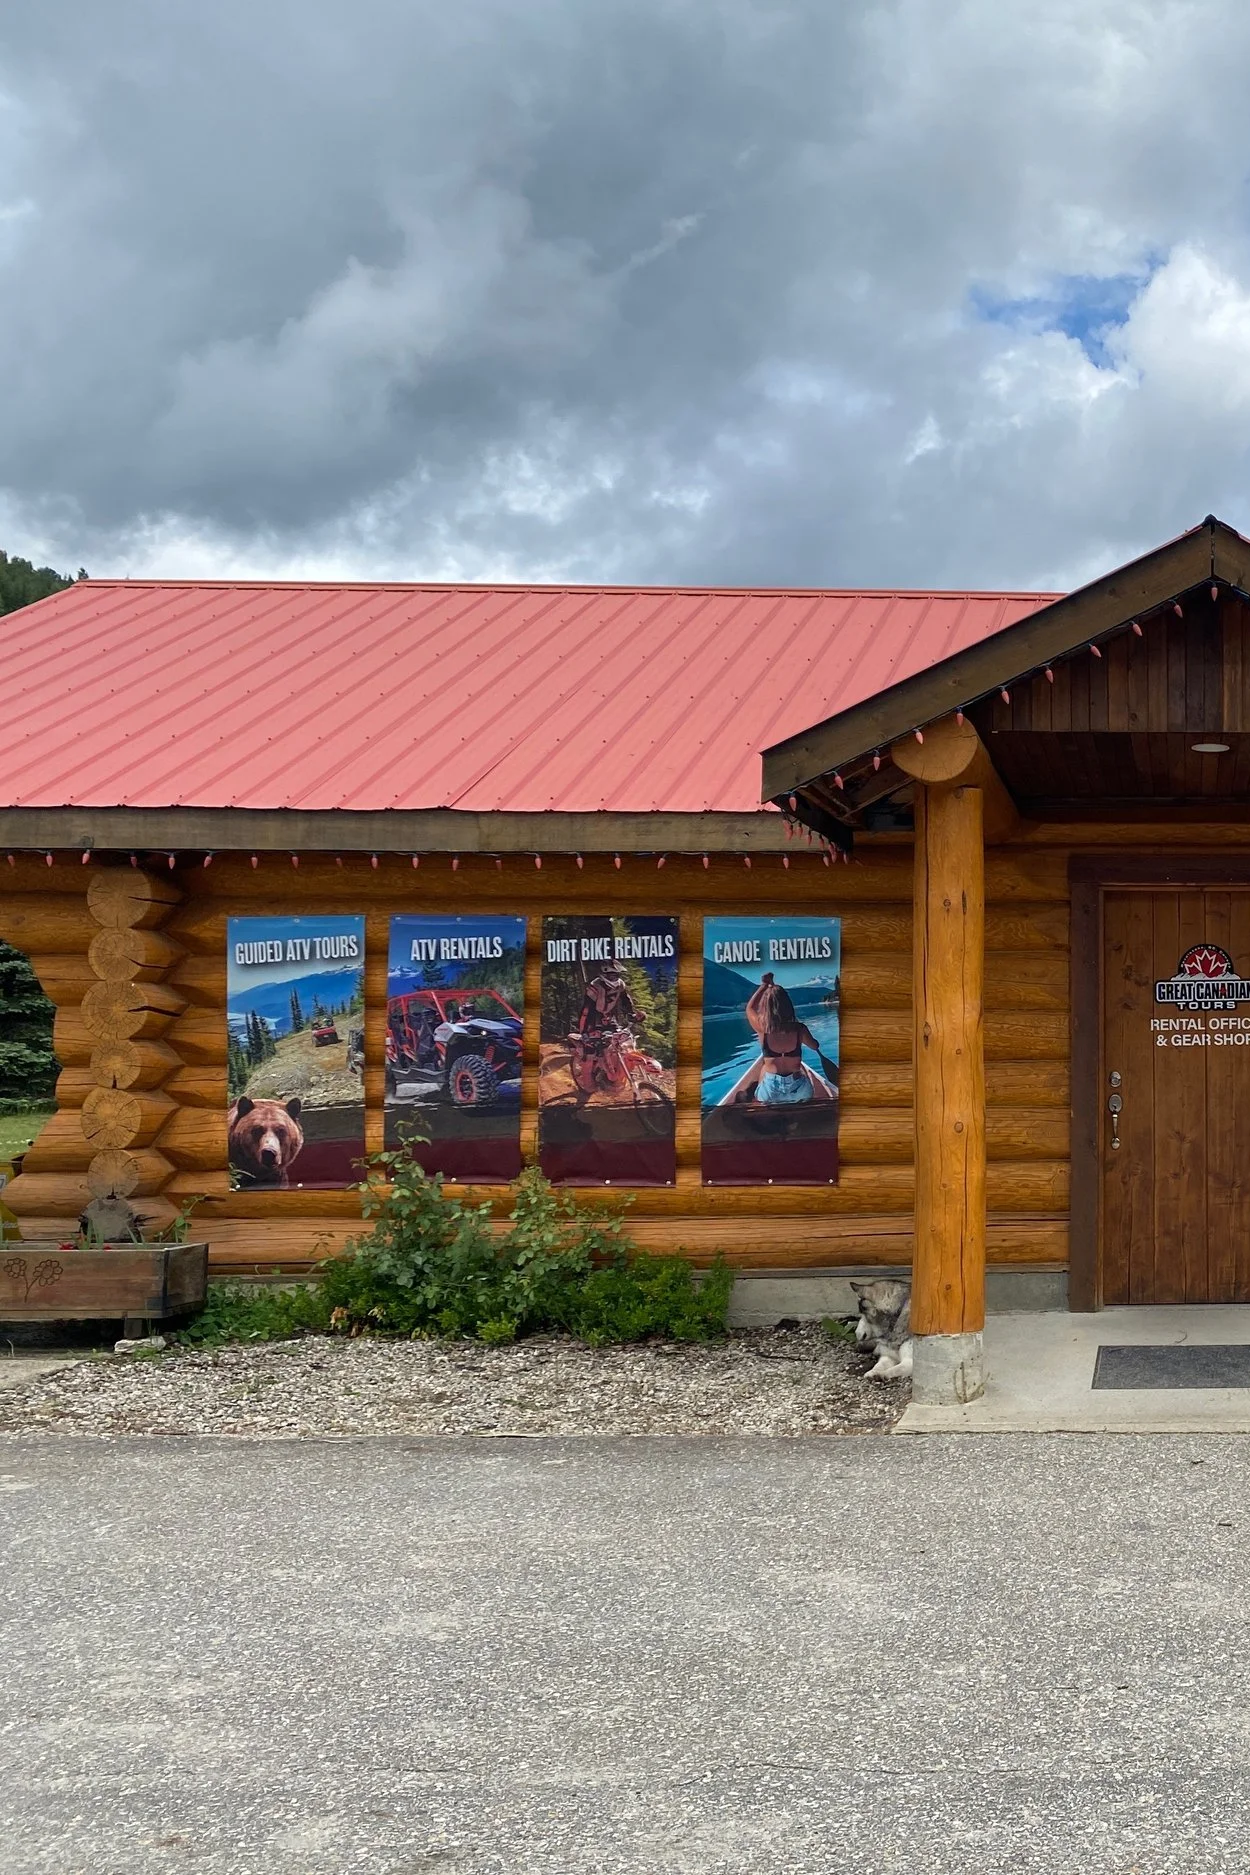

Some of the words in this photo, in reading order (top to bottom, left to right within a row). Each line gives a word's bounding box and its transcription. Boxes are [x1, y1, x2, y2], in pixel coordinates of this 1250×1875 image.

[235, 940, 282, 965] GUIDED
[286, 938, 313, 962] ATV
[313, 934, 359, 959] TOURS
[410, 938, 438, 961] ATV
[440, 936, 502, 960] RENTALS
[547, 938, 578, 963] DIRT
[580, 936, 612, 961] BIKE
[614, 934, 675, 960] RENTALS
[714, 940, 761, 963] CANOE
[768, 936, 831, 960] RENTALS
[1158, 983, 1193, 1000] GREAT
[1177, 1001, 1236, 1010] TOURS
[1150, 1019, 1206, 1031] RENTAL
[1156, 1034, 1168, 1047] &
[1171, 1034, 1211, 1046] GEAR
